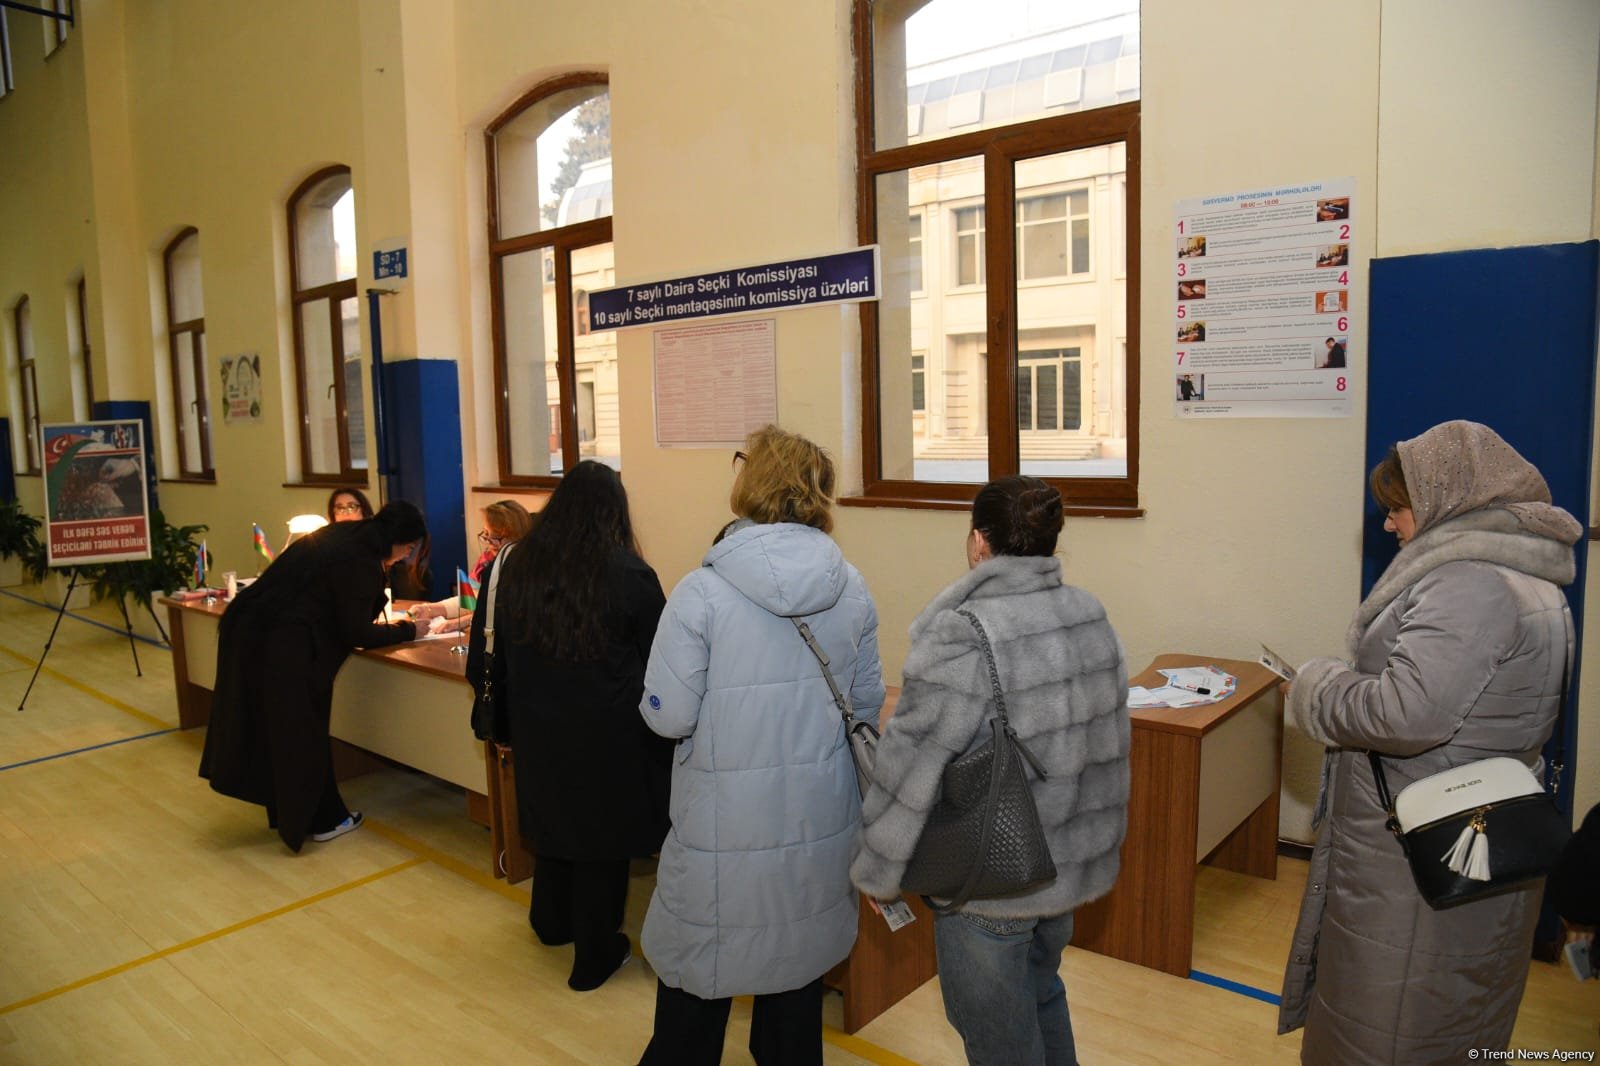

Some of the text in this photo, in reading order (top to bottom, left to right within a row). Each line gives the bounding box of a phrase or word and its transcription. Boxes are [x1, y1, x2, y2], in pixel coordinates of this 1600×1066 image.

[1177, 221, 1184, 234] 1
[1339, 225, 1350, 239] 2
[1177, 263, 1186, 277] 3
[627, 266, 818, 303] 7 saylı Dairə Seçki Komissiyası
[1338, 271, 1348, 285] 4
[594, 277, 869, 325] 10 saylı Seçki məntəqəsinin komissiya üzvləri
[1177, 305, 1186, 319] 5
[1337, 317, 1348, 332] 6
[1177, 352, 1185, 365] 7
[1336, 377, 1346, 391] 8
[96, 526, 110, 536] SƏS
[111, 524, 136, 534] VERƏN
